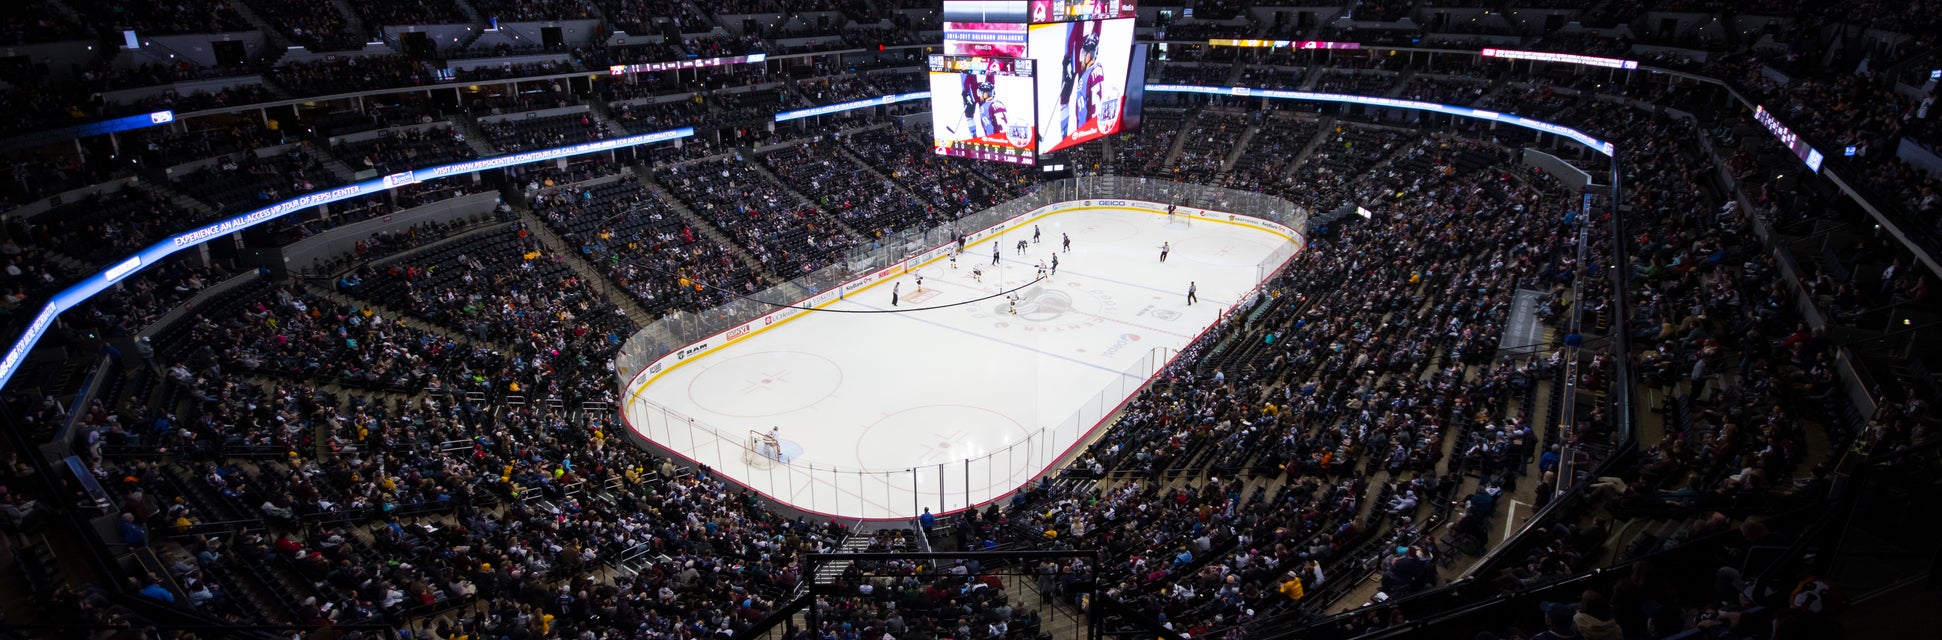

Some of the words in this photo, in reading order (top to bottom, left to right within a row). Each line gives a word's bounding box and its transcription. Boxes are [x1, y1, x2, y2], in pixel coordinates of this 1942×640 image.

[972, 33, 995, 41] COLORADO
[434, 165, 451, 175] VISIT
[452, 149, 551, 171] WWW.PEPSICENTER.COM/TOURS
[617, 138, 627, 146] FOR
[628, 135, 642, 145] MORE
[643, 131, 677, 141] INFORMATION
[174, 225, 219, 246] EXPERIENCE
[221, 220, 232, 232] AN
[233, 208, 271, 228] ALL-ACCESS
[271, 204, 282, 214] VIP
[282, 200, 300, 211] TOUR
[300, 195, 310, 205] OF
[312, 192, 331, 201] PEPSI
[332, 186, 359, 197] CENTER
[846, 281, 863, 291] KeyBank
[16, 339, 26, 355] FOR
[23, 327, 35, 346] MORE
[33, 301, 57, 333] INFORMATION
[686, 343, 708, 355] RAM
